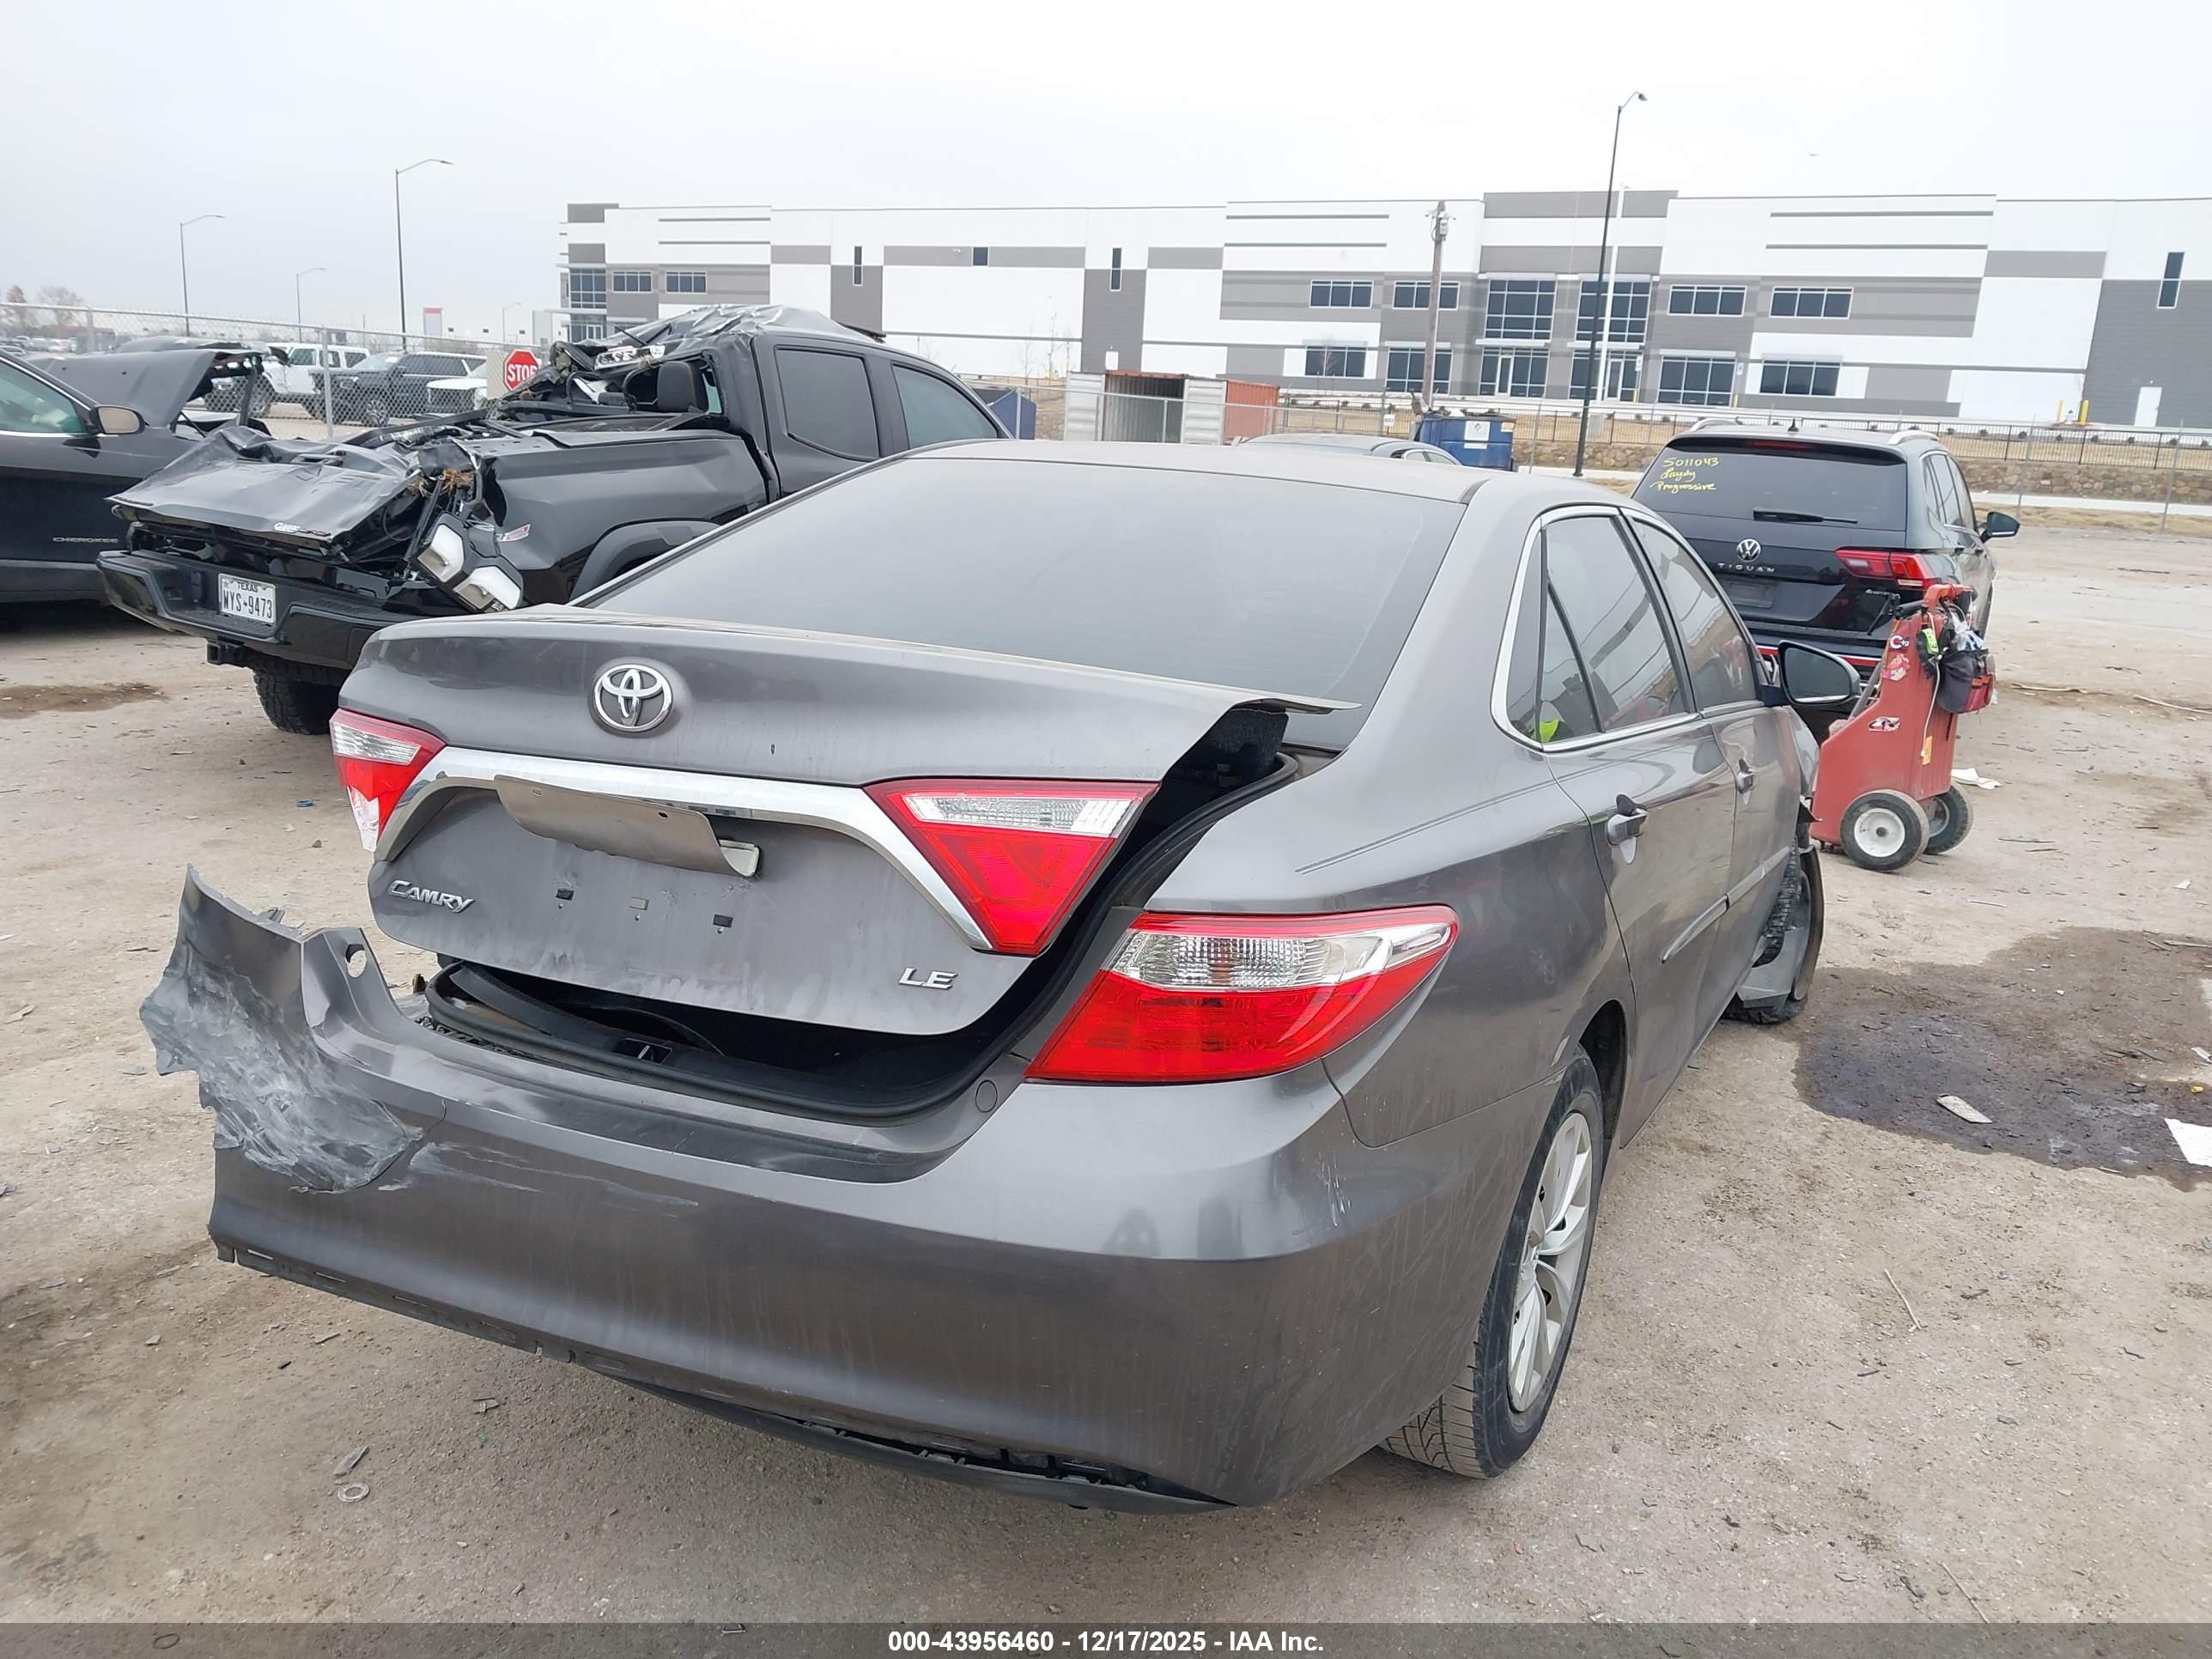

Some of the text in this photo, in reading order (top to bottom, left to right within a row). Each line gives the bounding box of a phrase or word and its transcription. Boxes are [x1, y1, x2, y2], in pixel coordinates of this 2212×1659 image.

[507, 363, 538, 382] STOP
[1718, 562, 1775, 573] TIGUAN
[237, 581, 258, 593] TEXAS
[389, 880, 475, 914] CAMRY
[898, 967, 958, 990] LE
